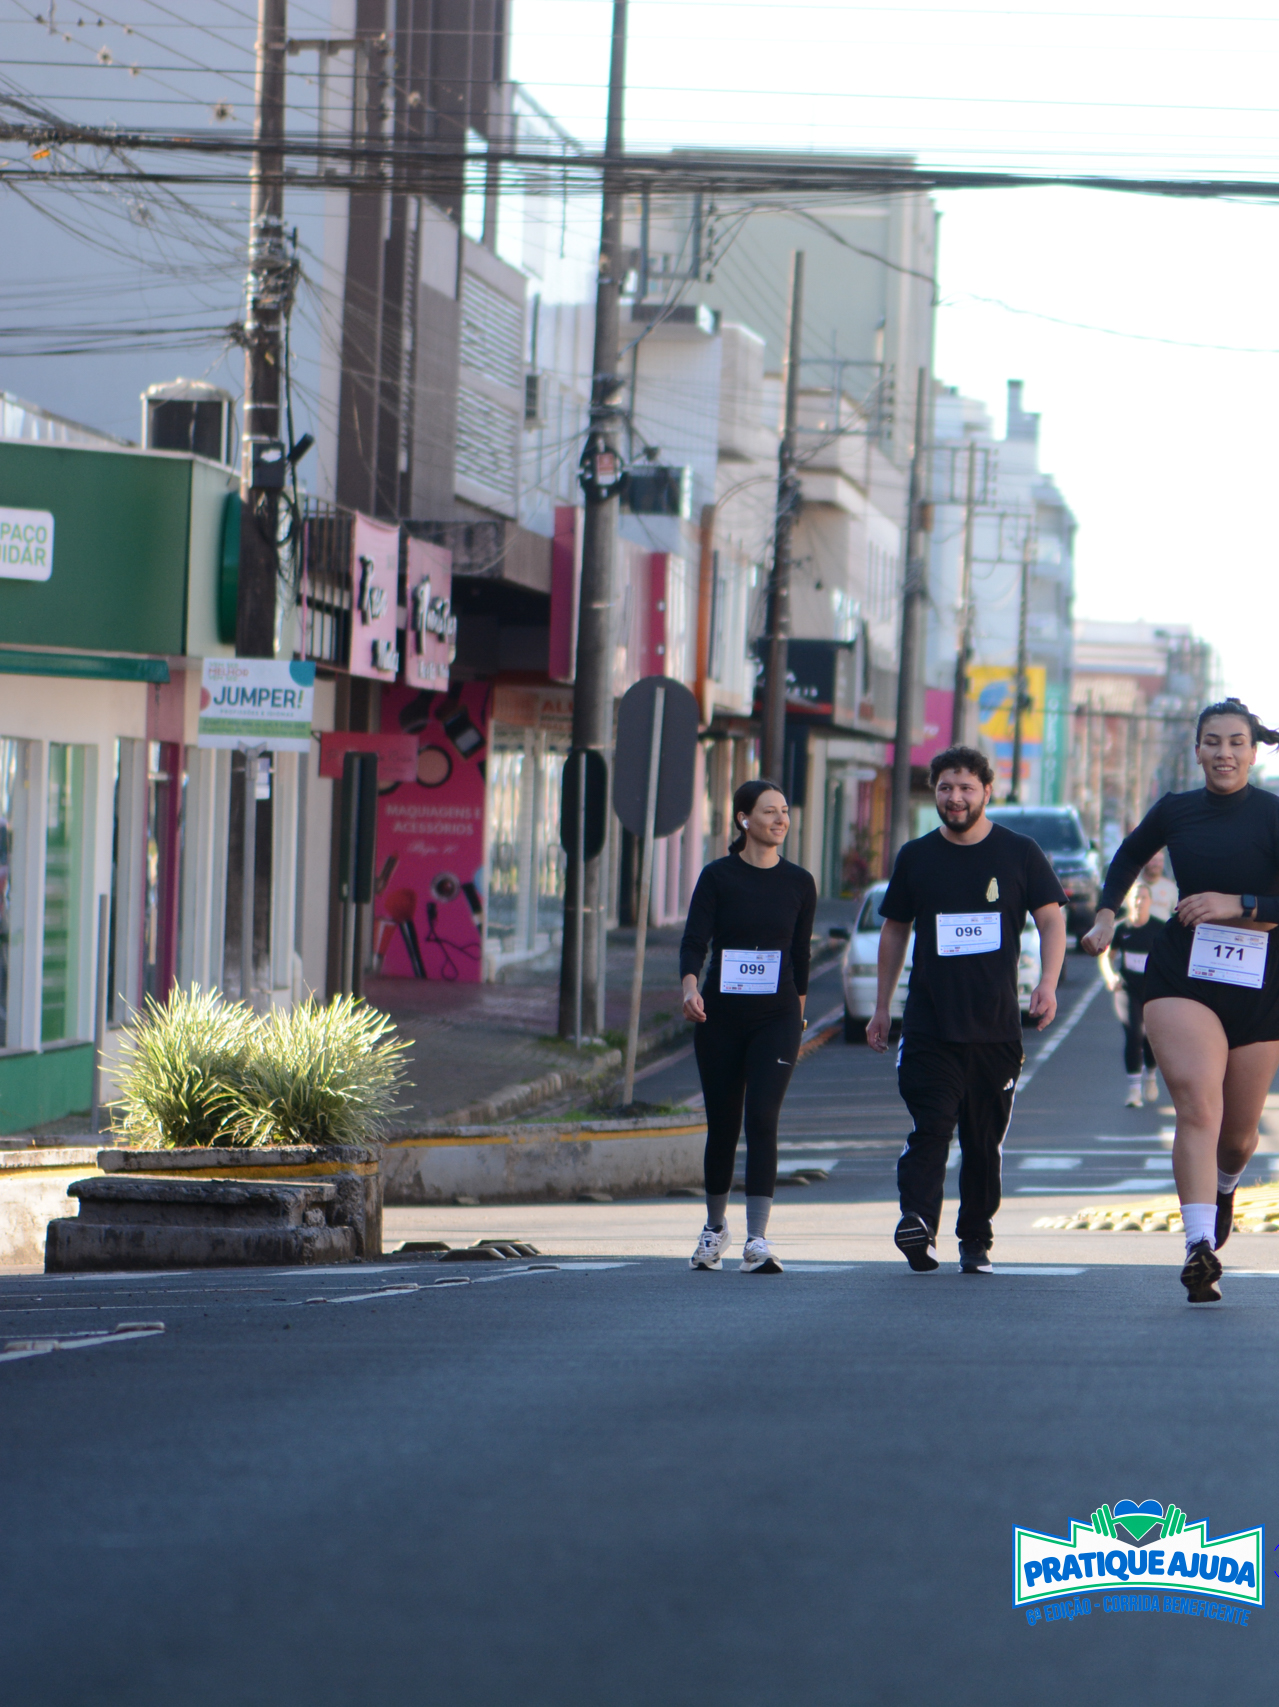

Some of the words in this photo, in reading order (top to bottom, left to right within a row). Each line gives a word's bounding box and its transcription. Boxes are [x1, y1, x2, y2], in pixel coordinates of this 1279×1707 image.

[0, 545, 46, 567] IDAR
[213, 686, 304, 709] JUMPER!
[386, 804, 472, 819] MAQUIAGENS
[955, 926, 982, 937] 096
[1214, 944, 1244, 961] 171
[739, 963, 765, 975] 099
